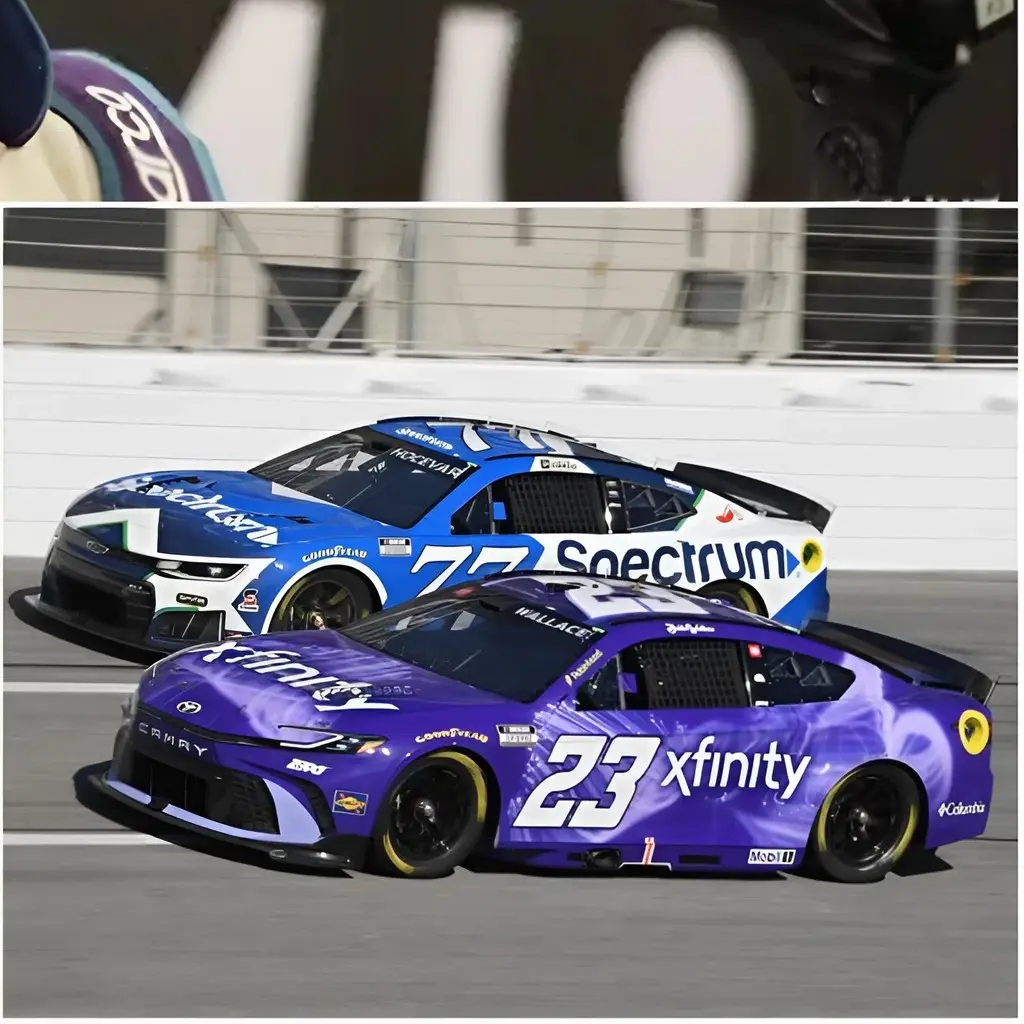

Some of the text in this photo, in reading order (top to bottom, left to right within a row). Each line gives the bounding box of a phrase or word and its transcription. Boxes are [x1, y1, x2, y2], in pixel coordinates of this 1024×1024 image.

[515, 606, 593, 640] WALLACE
[515, 734, 662, 827] 23
[661, 736, 811, 810] xfinity
